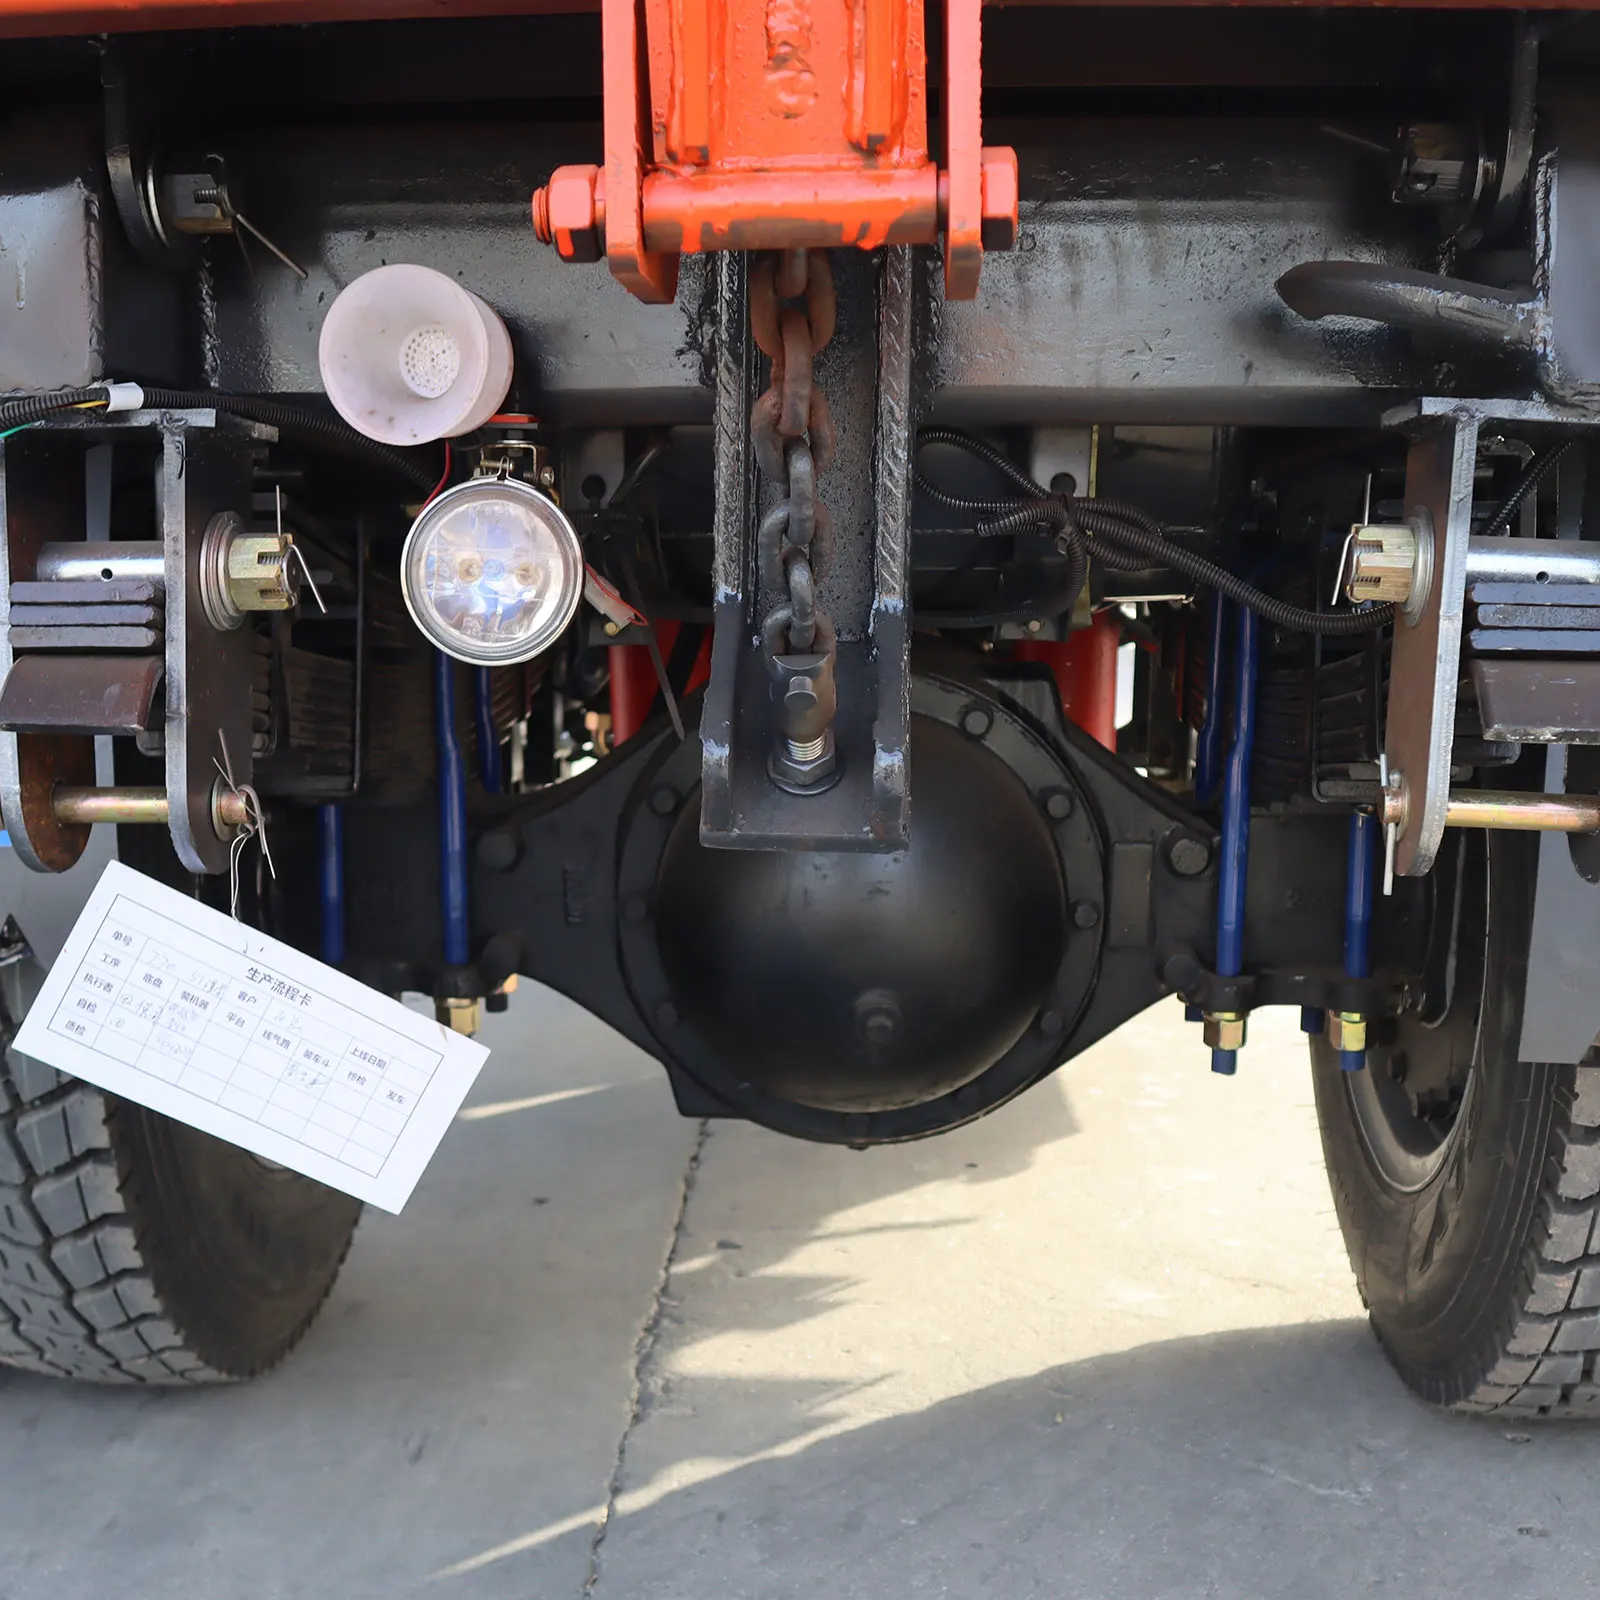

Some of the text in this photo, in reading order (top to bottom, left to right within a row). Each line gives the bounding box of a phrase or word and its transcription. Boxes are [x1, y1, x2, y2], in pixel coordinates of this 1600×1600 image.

[100, 953, 121, 968] 工序
[83, 972, 114, 993] 执行者
[142, 973, 163, 989] 底盘
[245, 967, 312, 1006] 生产流程卡
[238, 991, 257, 1004] 客户
[76, 998, 97, 1014] 自检
[227, 1012, 245, 1028] 平台
[350, 1047, 387, 1070] 上线日期
